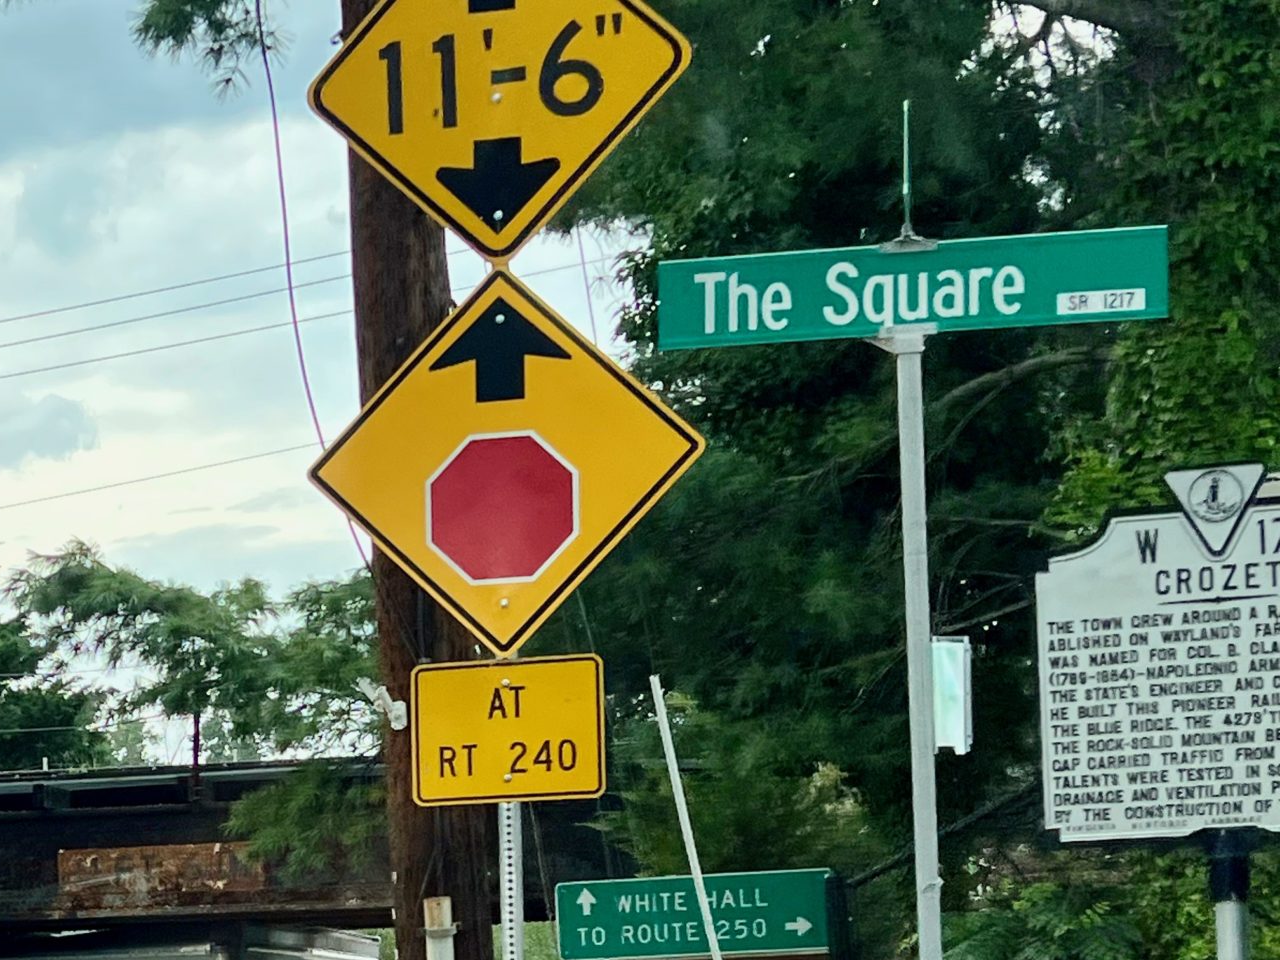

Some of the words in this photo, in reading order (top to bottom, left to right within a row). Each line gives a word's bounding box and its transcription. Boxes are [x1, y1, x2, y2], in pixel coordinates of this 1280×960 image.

[693, 271, 792, 334] The
[822, 261, 1025, 327] Square
[1067, 294, 1089, 311] SR
[1103, 291, 1136, 309] 1217
[1136, 528, 1158, 564] W
[1155, 561, 1280, 595] CROZET
[1047, 620, 1074, 635] THE
[1081, 617, 1122, 632] TOWN
[1181, 607, 1241, 624] AROUND
[1249, 606, 1258, 620] A
[1048, 634, 1121, 652] ABLISHED
[1129, 632, 1148, 645] ON
[1160, 623, 1241, 643] WAYLAND'S
[1048, 655, 1079, 669] WAS
[1089, 650, 1138, 667] NAMED
[1149, 647, 1176, 662] FOR
[487, 686, 525, 720] AT
[1049, 689, 1077, 704] THE
[1084, 683, 1138, 701] STATE'S
[1149, 679, 1223, 697] ENGINEER
[1235, 676, 1264, 691] AND
[1050, 707, 1069, 721] HE
[1078, 703, 1117, 719] BUILT
[1126, 701, 1158, 716] THIS
[1172, 696, 1236, 712] PIONEER
[1051, 724, 1079, 738] THE
[1087, 720, 1123, 735] BLUE
[1184, 714, 1212, 729] THE
[1051, 741, 1080, 755] THE
[1087, 735, 1173, 752] ROCK-SOLID
[1181, 731, 1255, 747] MOUNTAIN
[438, 744, 478, 778] RT
[509, 739, 577, 774] 240
[1052, 758, 1080, 772] GAP
[1087, 753, 1150, 770] CARRIED
[1161, 749, 1223, 766] TRAFFIC
[1236, 746, 1275, 761] FROM
[1053, 773, 1119, 790] TALENTS
[1127, 770, 1169, 784] WERE
[1178, 766, 1233, 782] TESTED
[1246, 765, 1260, 778] IN
[1053, 790, 1124, 806] DRAINAGE
[1131, 787, 1158, 802] AND
[1165, 782, 1261, 800] VENTILATION
[1054, 810, 1072, 823] BY
[1083, 808, 1111, 821] THE
[1124, 801, 1243, 819] CONSTRUCTION
[1255, 799, 1273, 813] OF
[618, 891, 687, 913] WHITE
[706, 888, 769, 909] HALL
[577, 927, 606, 947] TO
[621, 921, 700, 944] ROUTE
[716, 918, 767, 940] 250
